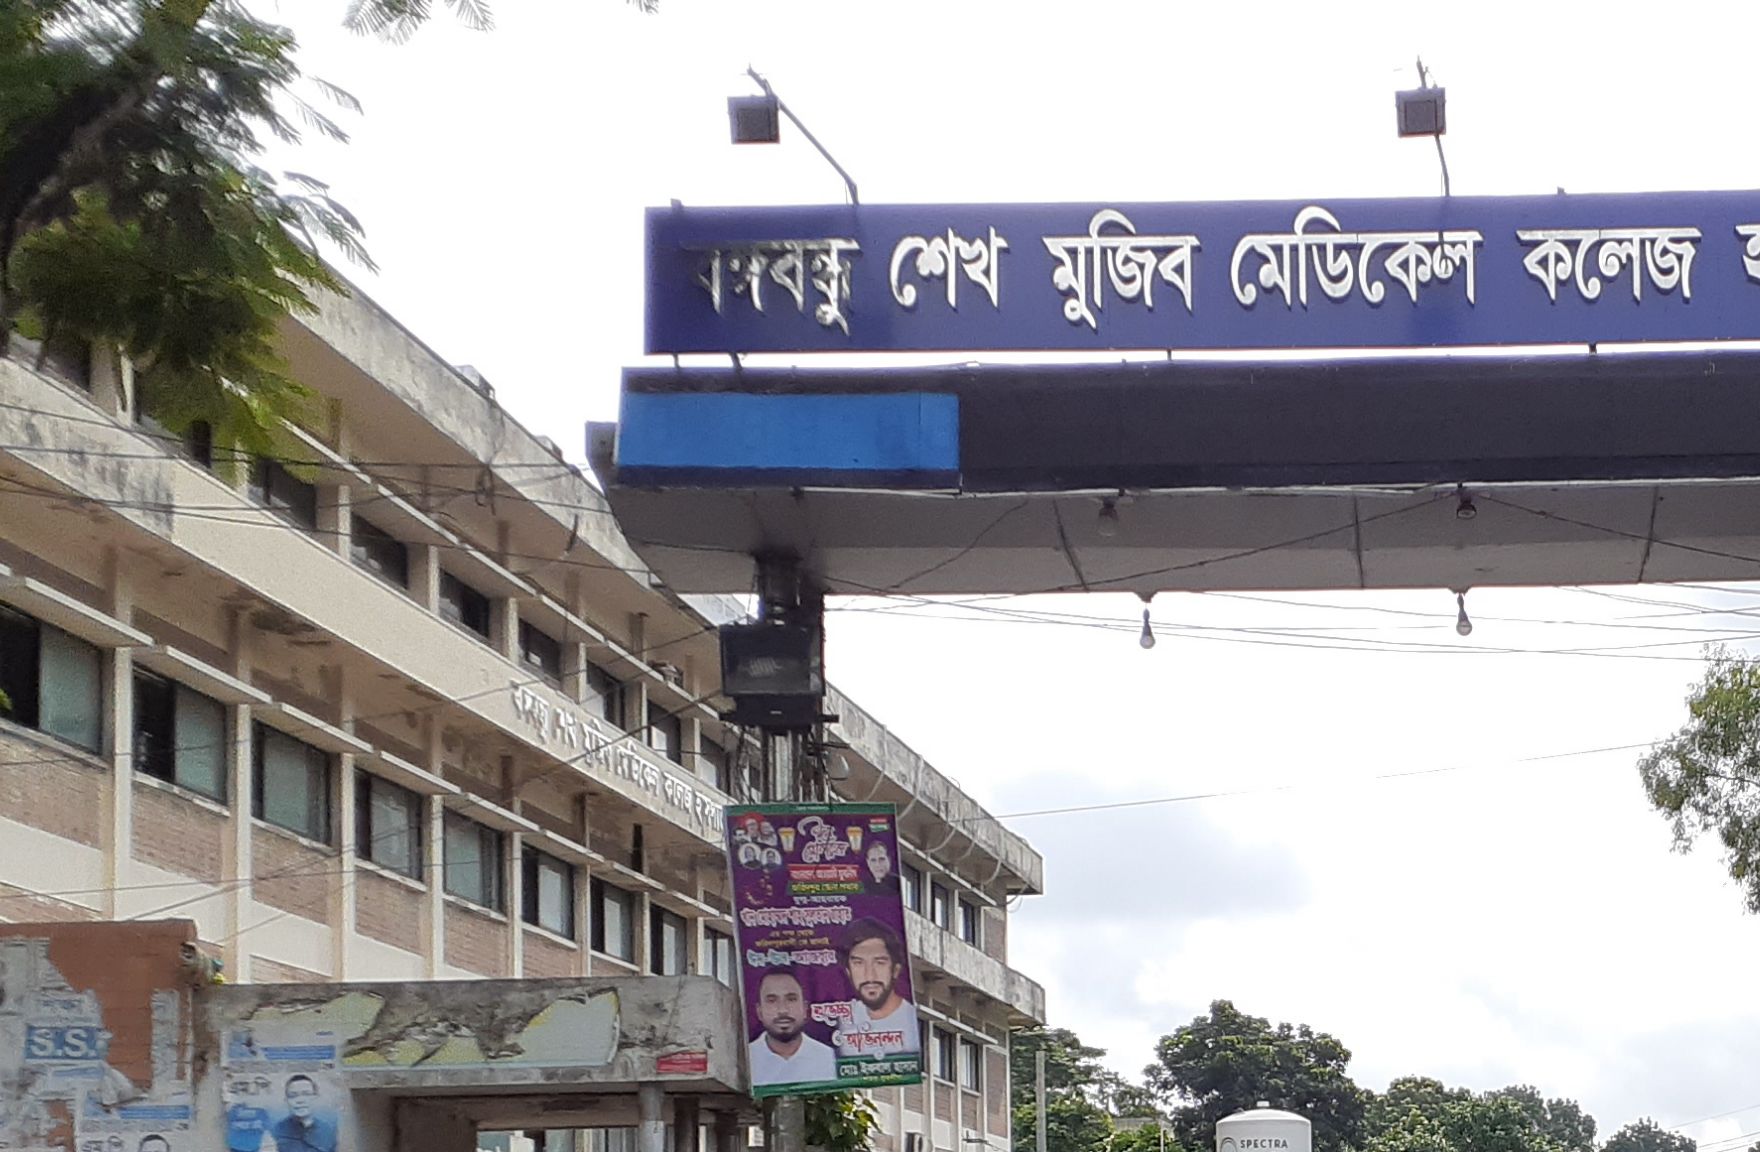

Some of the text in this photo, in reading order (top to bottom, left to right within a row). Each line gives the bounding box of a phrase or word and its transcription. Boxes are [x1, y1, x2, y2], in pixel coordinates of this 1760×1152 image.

[890, 226, 1008, 309] শেখ
[1043, 207, 1200, 330] মুজিব
[1231, 206, 1483, 307] মেডিকেল
[1516, 226, 1702, 302] কলেজ
[1240, 1139, 1288, 1149] SPECTRA
